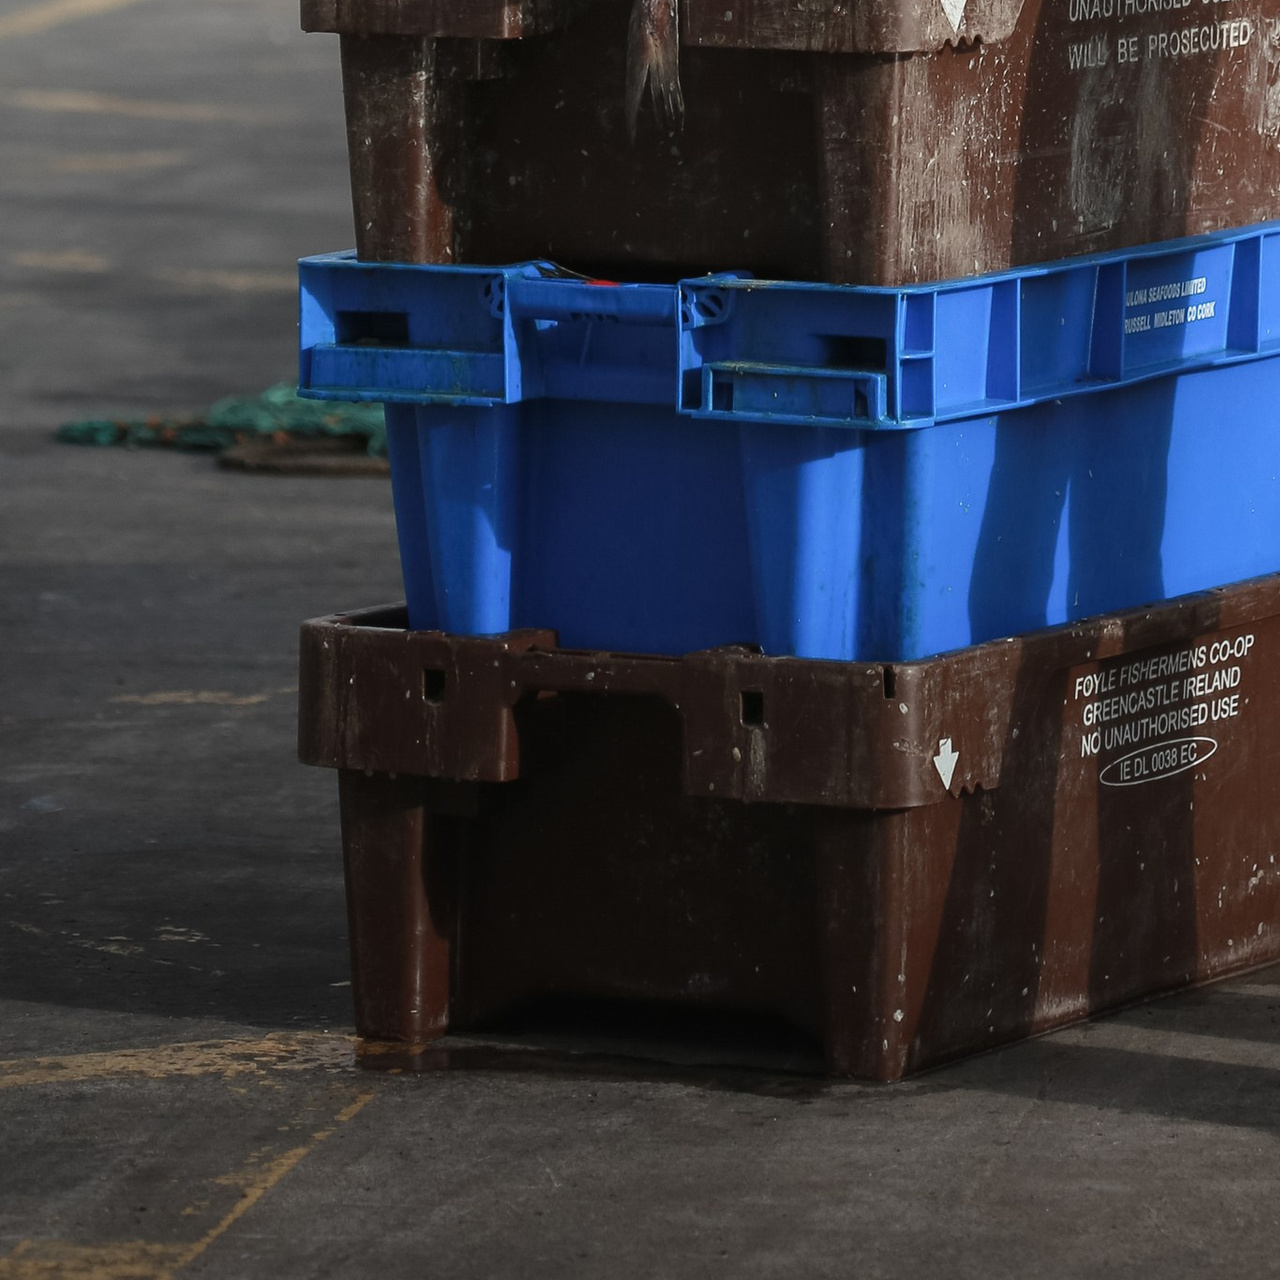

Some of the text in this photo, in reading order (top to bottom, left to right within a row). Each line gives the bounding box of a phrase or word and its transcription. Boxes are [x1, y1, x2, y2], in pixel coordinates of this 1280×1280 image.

[1068, 21, 1251, 70] WILL BE PROSECUTED
[1148, 282, 1181, 303] SEAFOODS
[1181, 277, 1206, 297] LIMITED
[1154, 308, 1186, 329] MIDLETON
[1187, 305, 1197, 322] CO
[1197, 301, 1216, 320] CORK
[1074, 634, 1255, 700] FOYLE FISHERMENS CO-OP
[1083, 666, 1241, 726] GREENCASTLE IRELAND
[1081, 694, 1239, 758] NO UNAUTHORISED USE
[1119, 743, 1198, 781] IE DL 0038 EC
